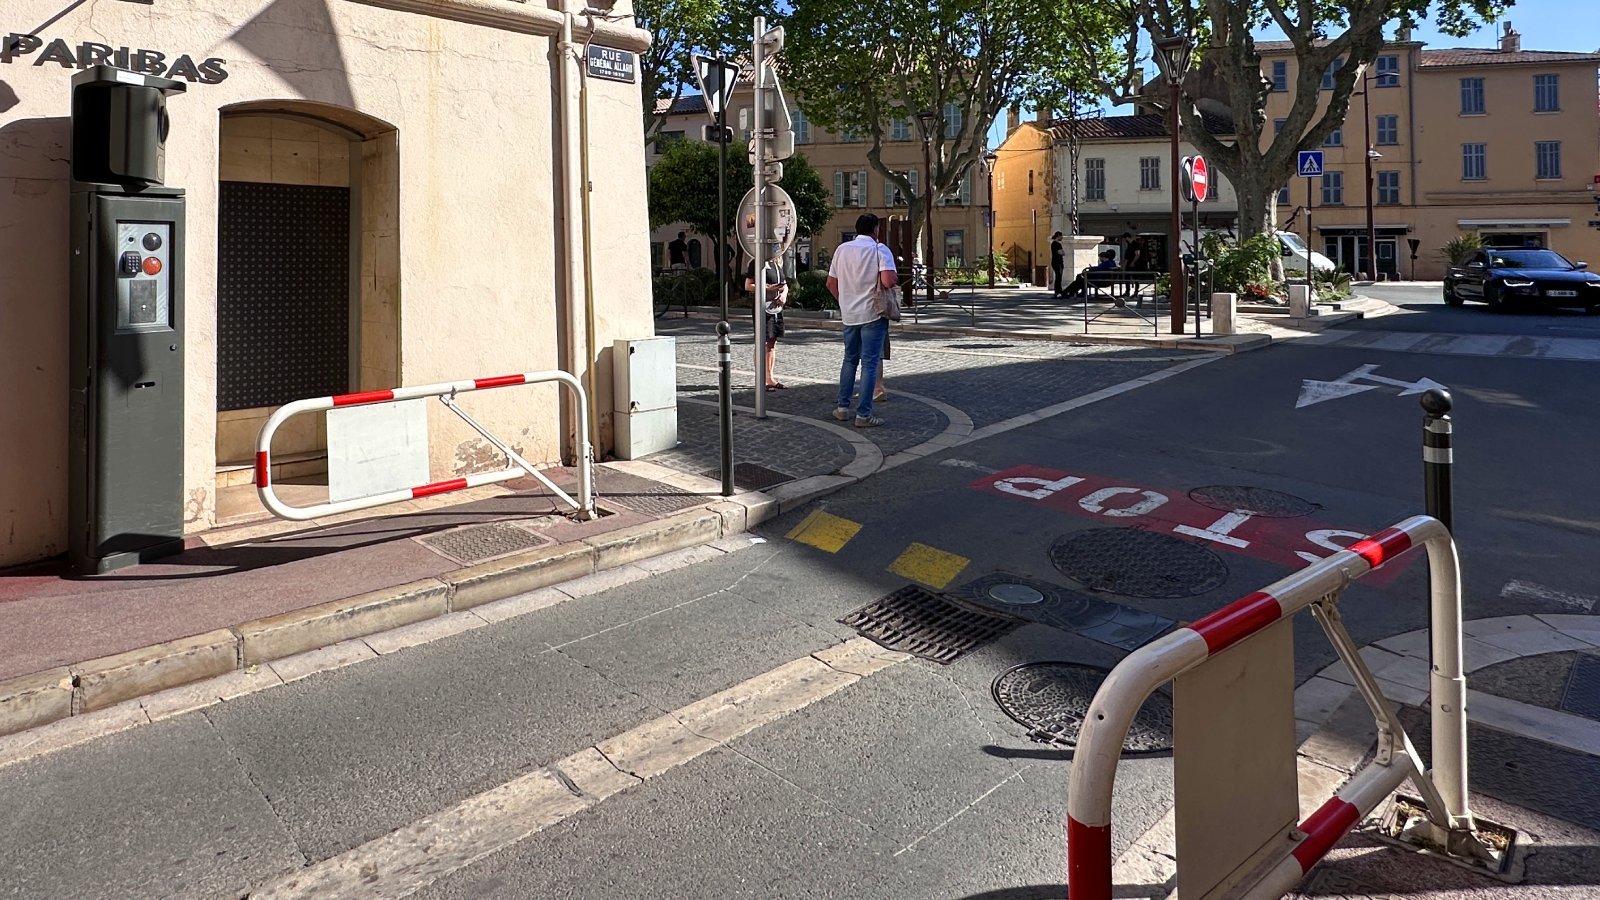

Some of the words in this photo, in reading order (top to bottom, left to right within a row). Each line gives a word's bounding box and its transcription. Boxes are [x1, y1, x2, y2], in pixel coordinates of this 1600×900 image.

[8, 33, 229, 84] PARIBAS
[589, 57, 612, 70] GÉNÉRAL
[601, 50, 622, 61] RUE
[993, 475, 1372, 567] STOP
